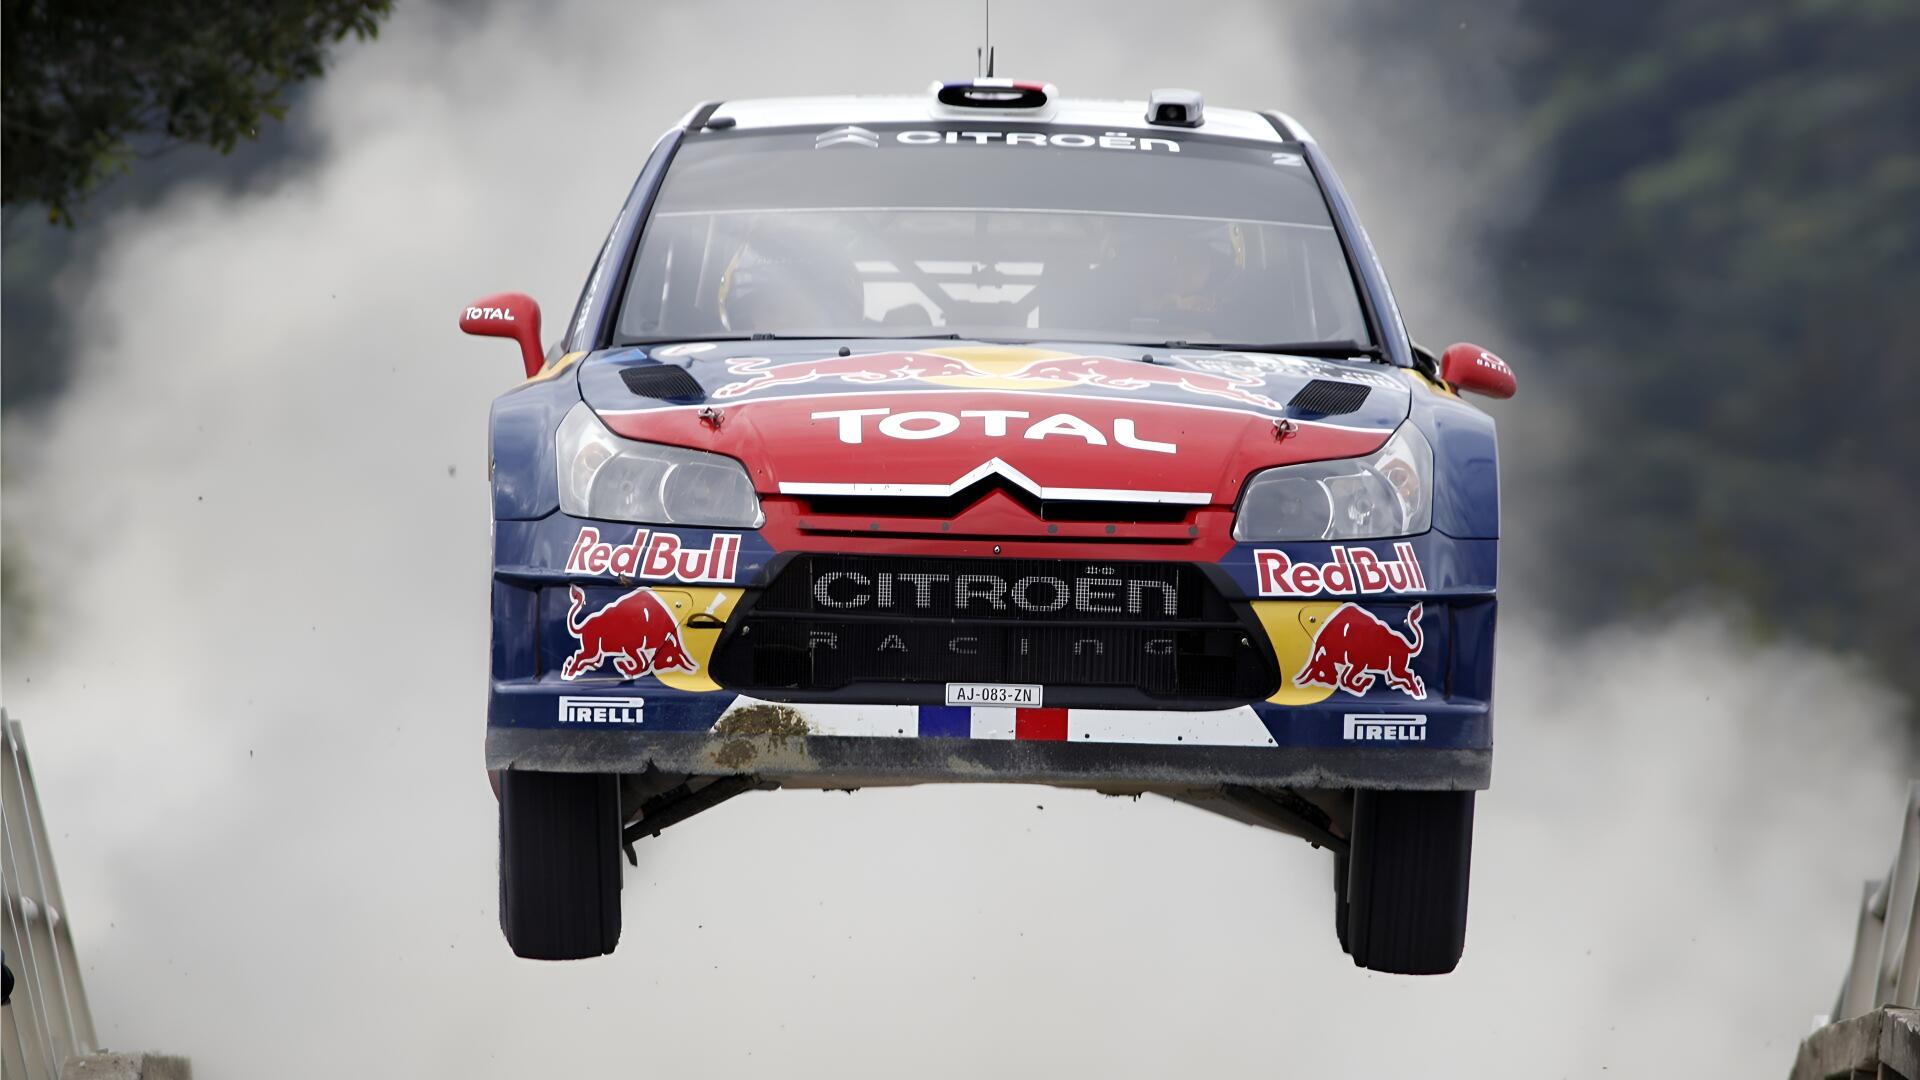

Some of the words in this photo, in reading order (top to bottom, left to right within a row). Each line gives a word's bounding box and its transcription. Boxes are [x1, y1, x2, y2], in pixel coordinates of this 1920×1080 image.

[1271, 153, 1303, 166] 2
[466, 307, 515, 321] TOTAL
[811, 407, 1177, 454] TOTAL
[565, 527, 649, 577] Red
[640, 533, 741, 582] Bull
[1254, 546, 1356, 596] Red
[1348, 542, 1426, 593] Bull
[957, 687, 1032, 702] AJ-083-ZN
[559, 696, 644, 723] PIRELLI
[1343, 714, 1428, 741] PIRELLI
